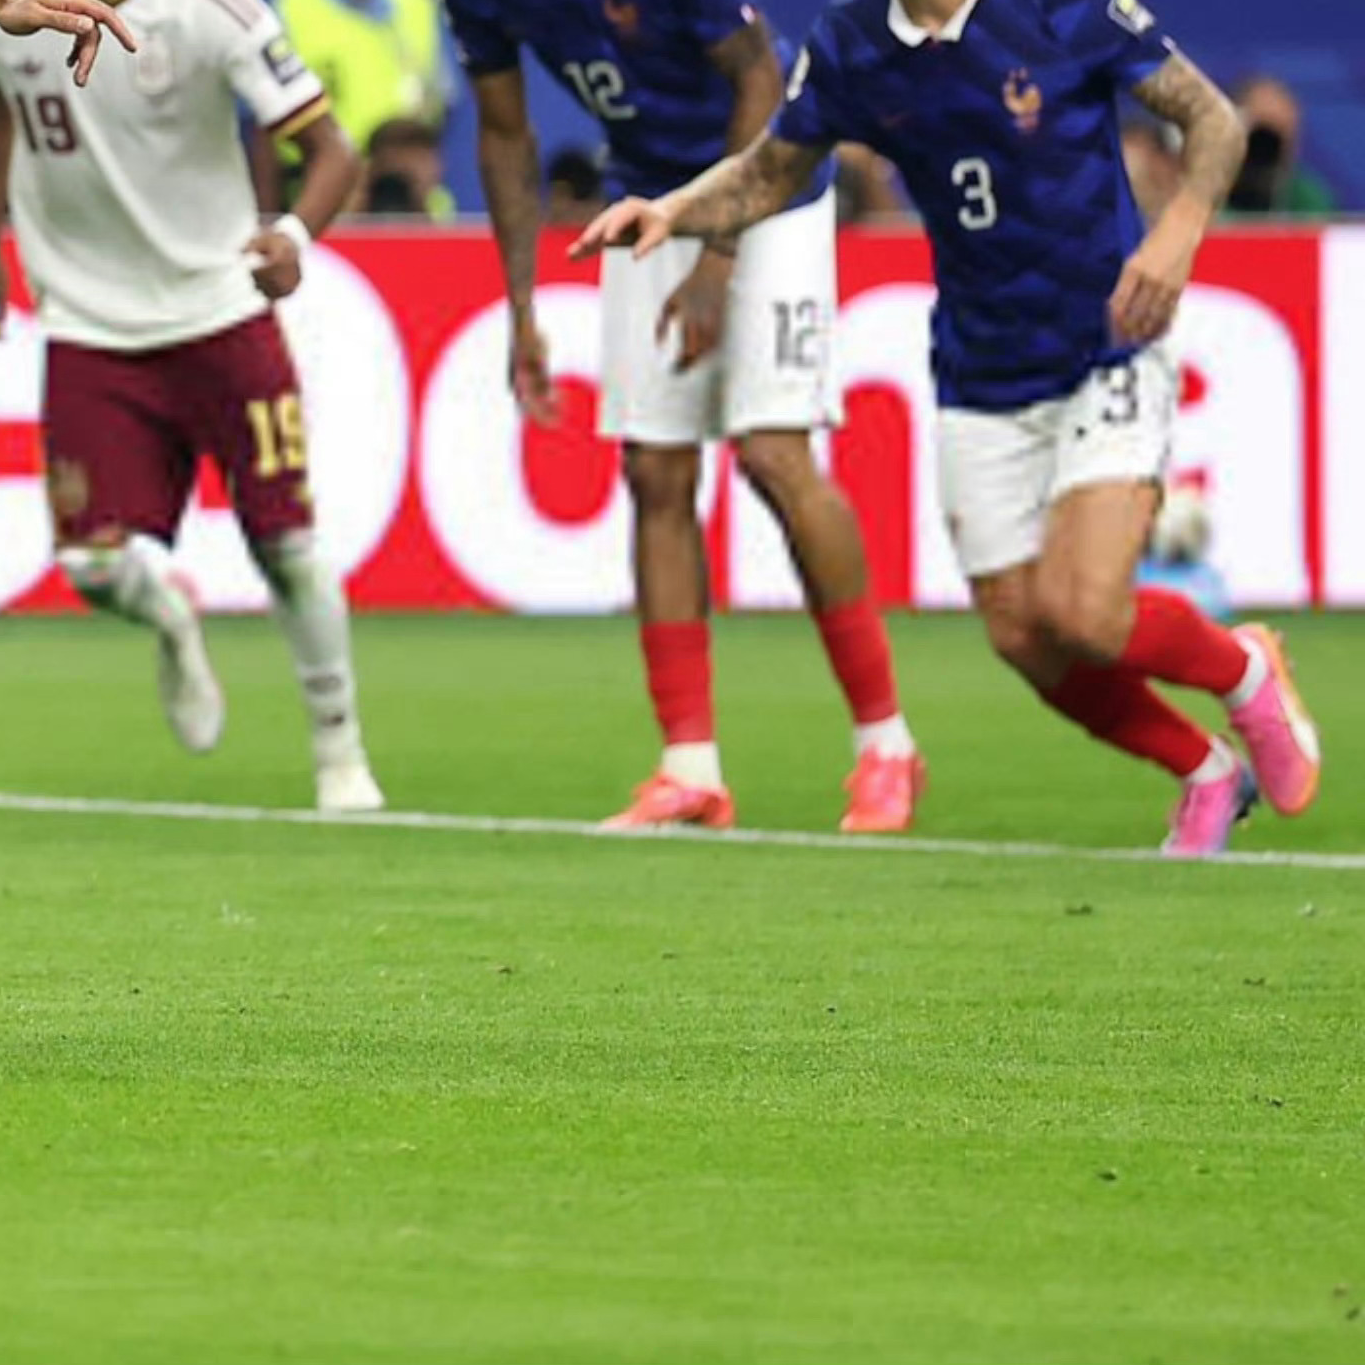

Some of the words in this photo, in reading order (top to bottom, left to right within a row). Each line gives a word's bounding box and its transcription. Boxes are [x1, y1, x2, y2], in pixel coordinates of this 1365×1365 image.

[563, 60, 636, 119] 12
[15, 94, 77, 153] 19
[953, 161, 995, 227] 3
[1098, 366, 1139, 423] 3
